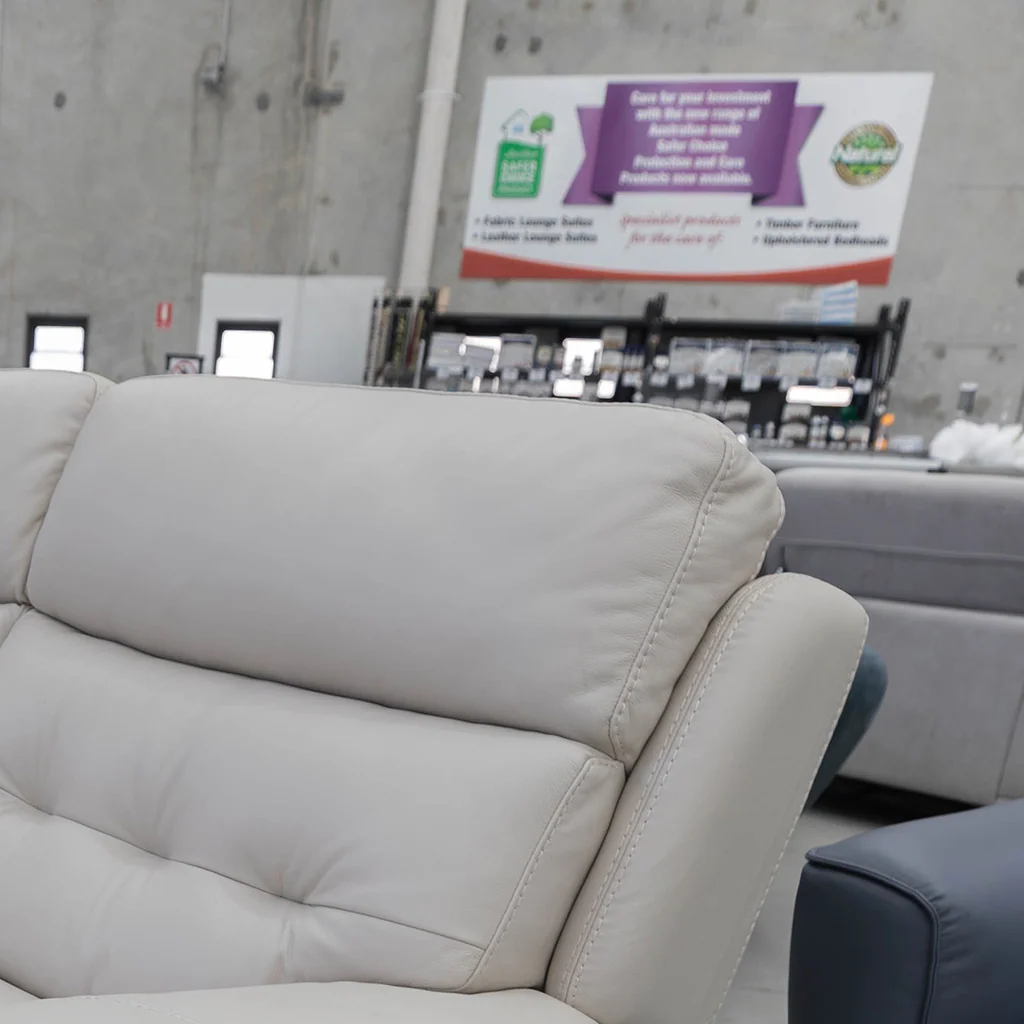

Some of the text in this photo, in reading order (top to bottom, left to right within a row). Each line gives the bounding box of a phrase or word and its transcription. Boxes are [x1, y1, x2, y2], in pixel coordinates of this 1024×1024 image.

[630, 89, 772, 106] Care for your investment
[635, 106, 761, 122] with the new range of
[648, 123, 742, 137] Australian made
[656, 139, 729, 153] Safer Choice
[633, 155, 745, 169] Protection and Care
[619, 170, 670, 185] Products
[672, 172, 696, 184] now
[519, 216, 557, 229] Lounge
[561, 216, 593, 227] Suites
[807, 218, 860, 231] Furniture
[524, 232, 562, 245] Lounge
[566, 231, 598, 243] Suites
